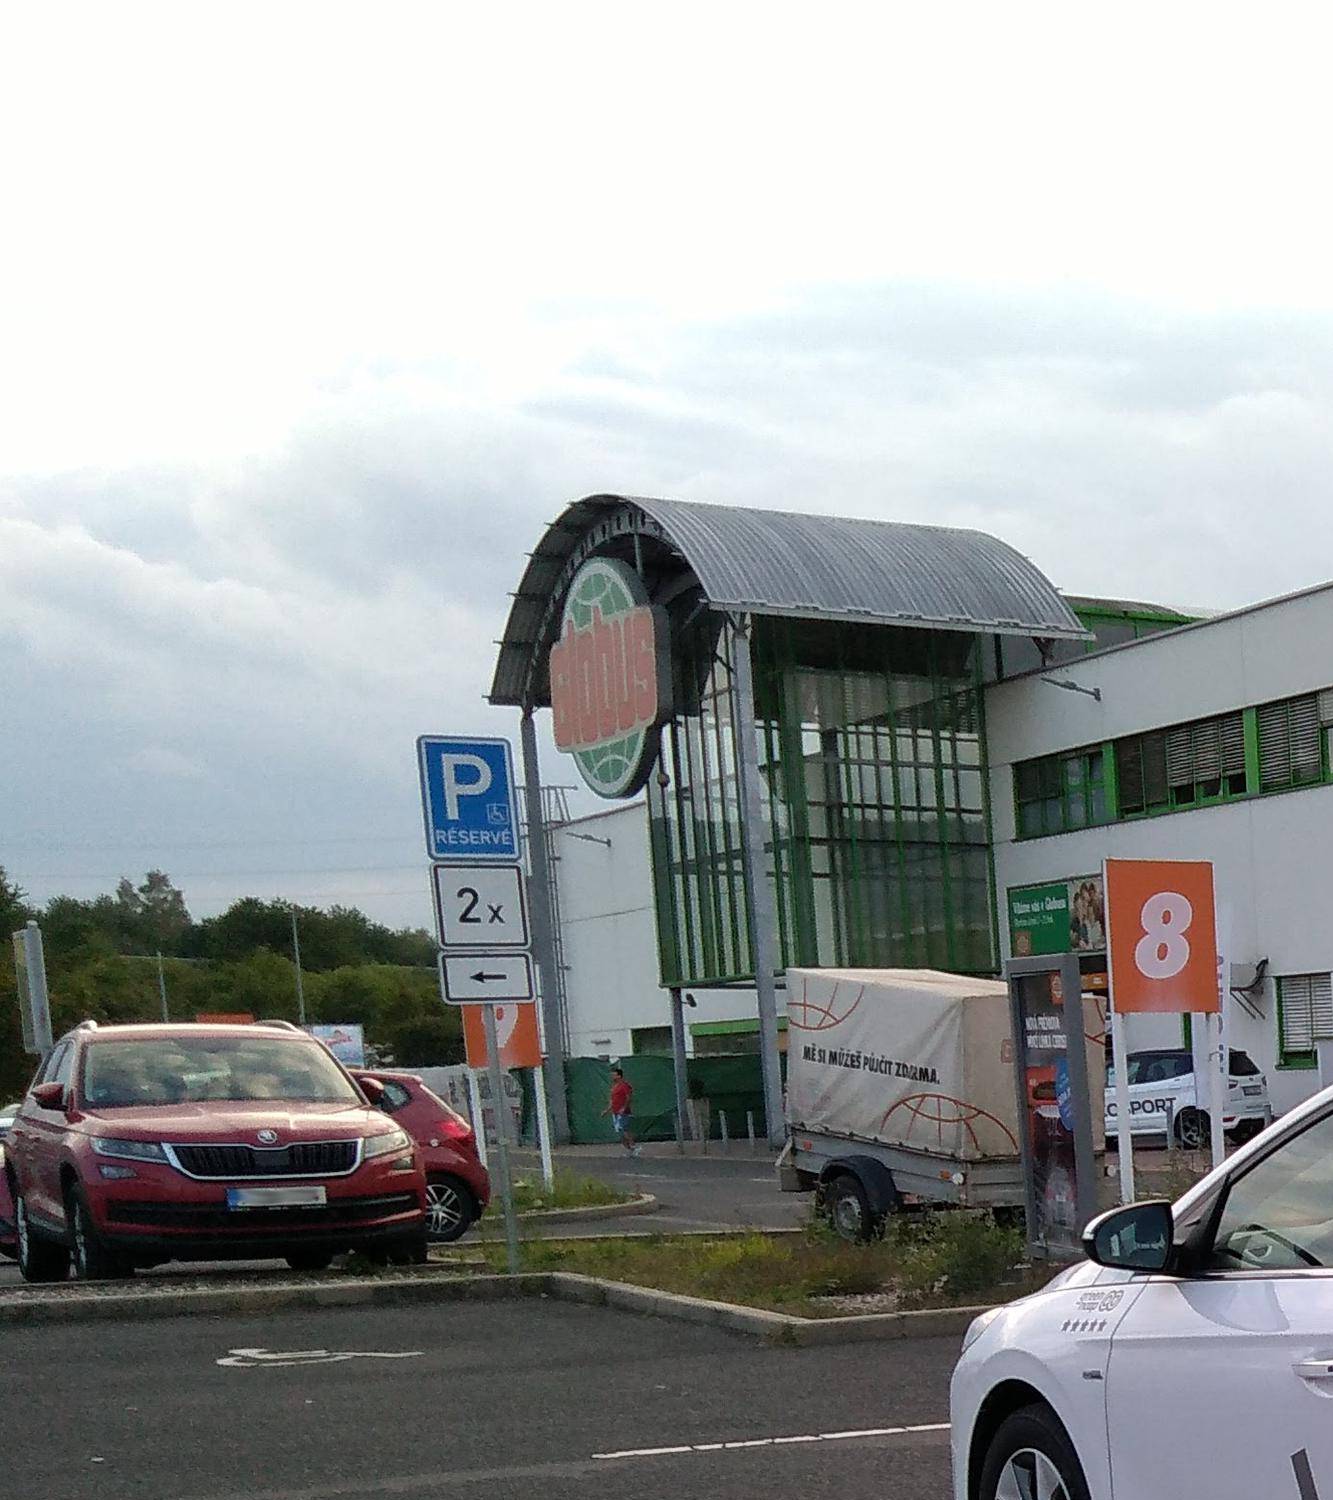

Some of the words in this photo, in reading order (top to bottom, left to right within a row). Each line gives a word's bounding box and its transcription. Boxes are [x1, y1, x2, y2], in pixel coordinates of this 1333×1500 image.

[441, 754, 492, 820] P
[435, 828, 512, 845] RÉSERVÉ
[1135, 891, 1193, 979] 8
